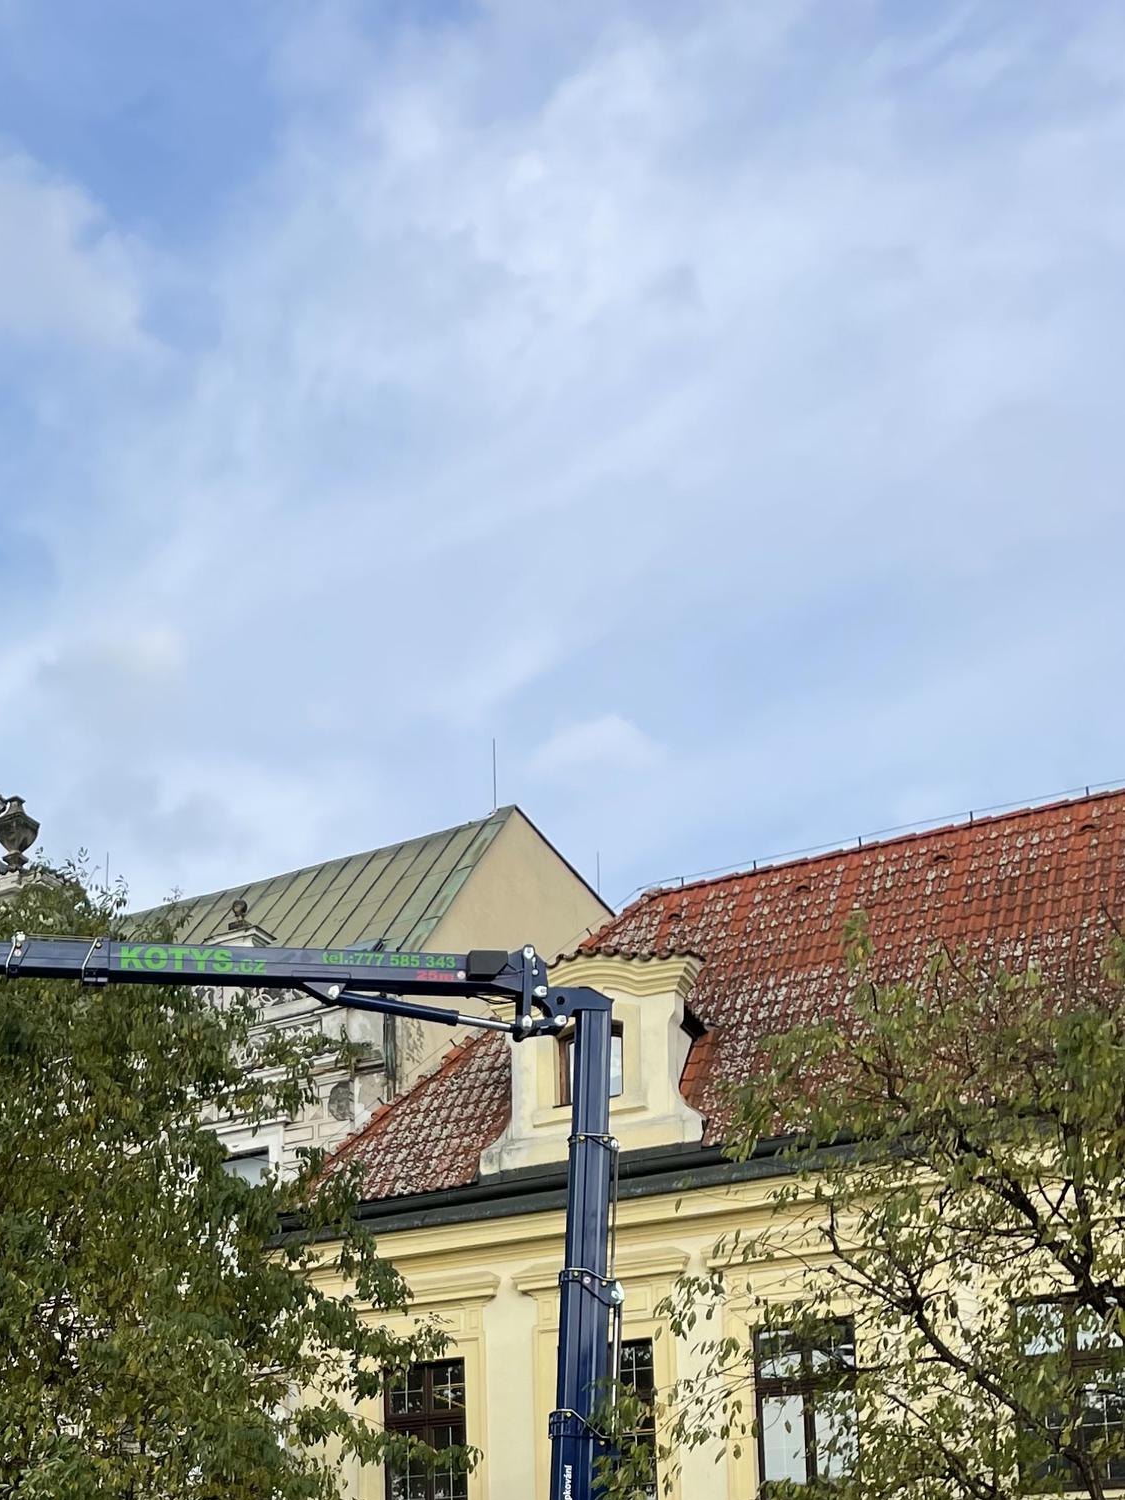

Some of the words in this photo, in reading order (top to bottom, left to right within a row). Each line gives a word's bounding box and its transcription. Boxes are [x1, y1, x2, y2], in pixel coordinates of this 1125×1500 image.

[120, 945, 268, 974] KOTYS.cz
[389, 954, 420, 968] 585
[425, 955, 457, 969] 343
